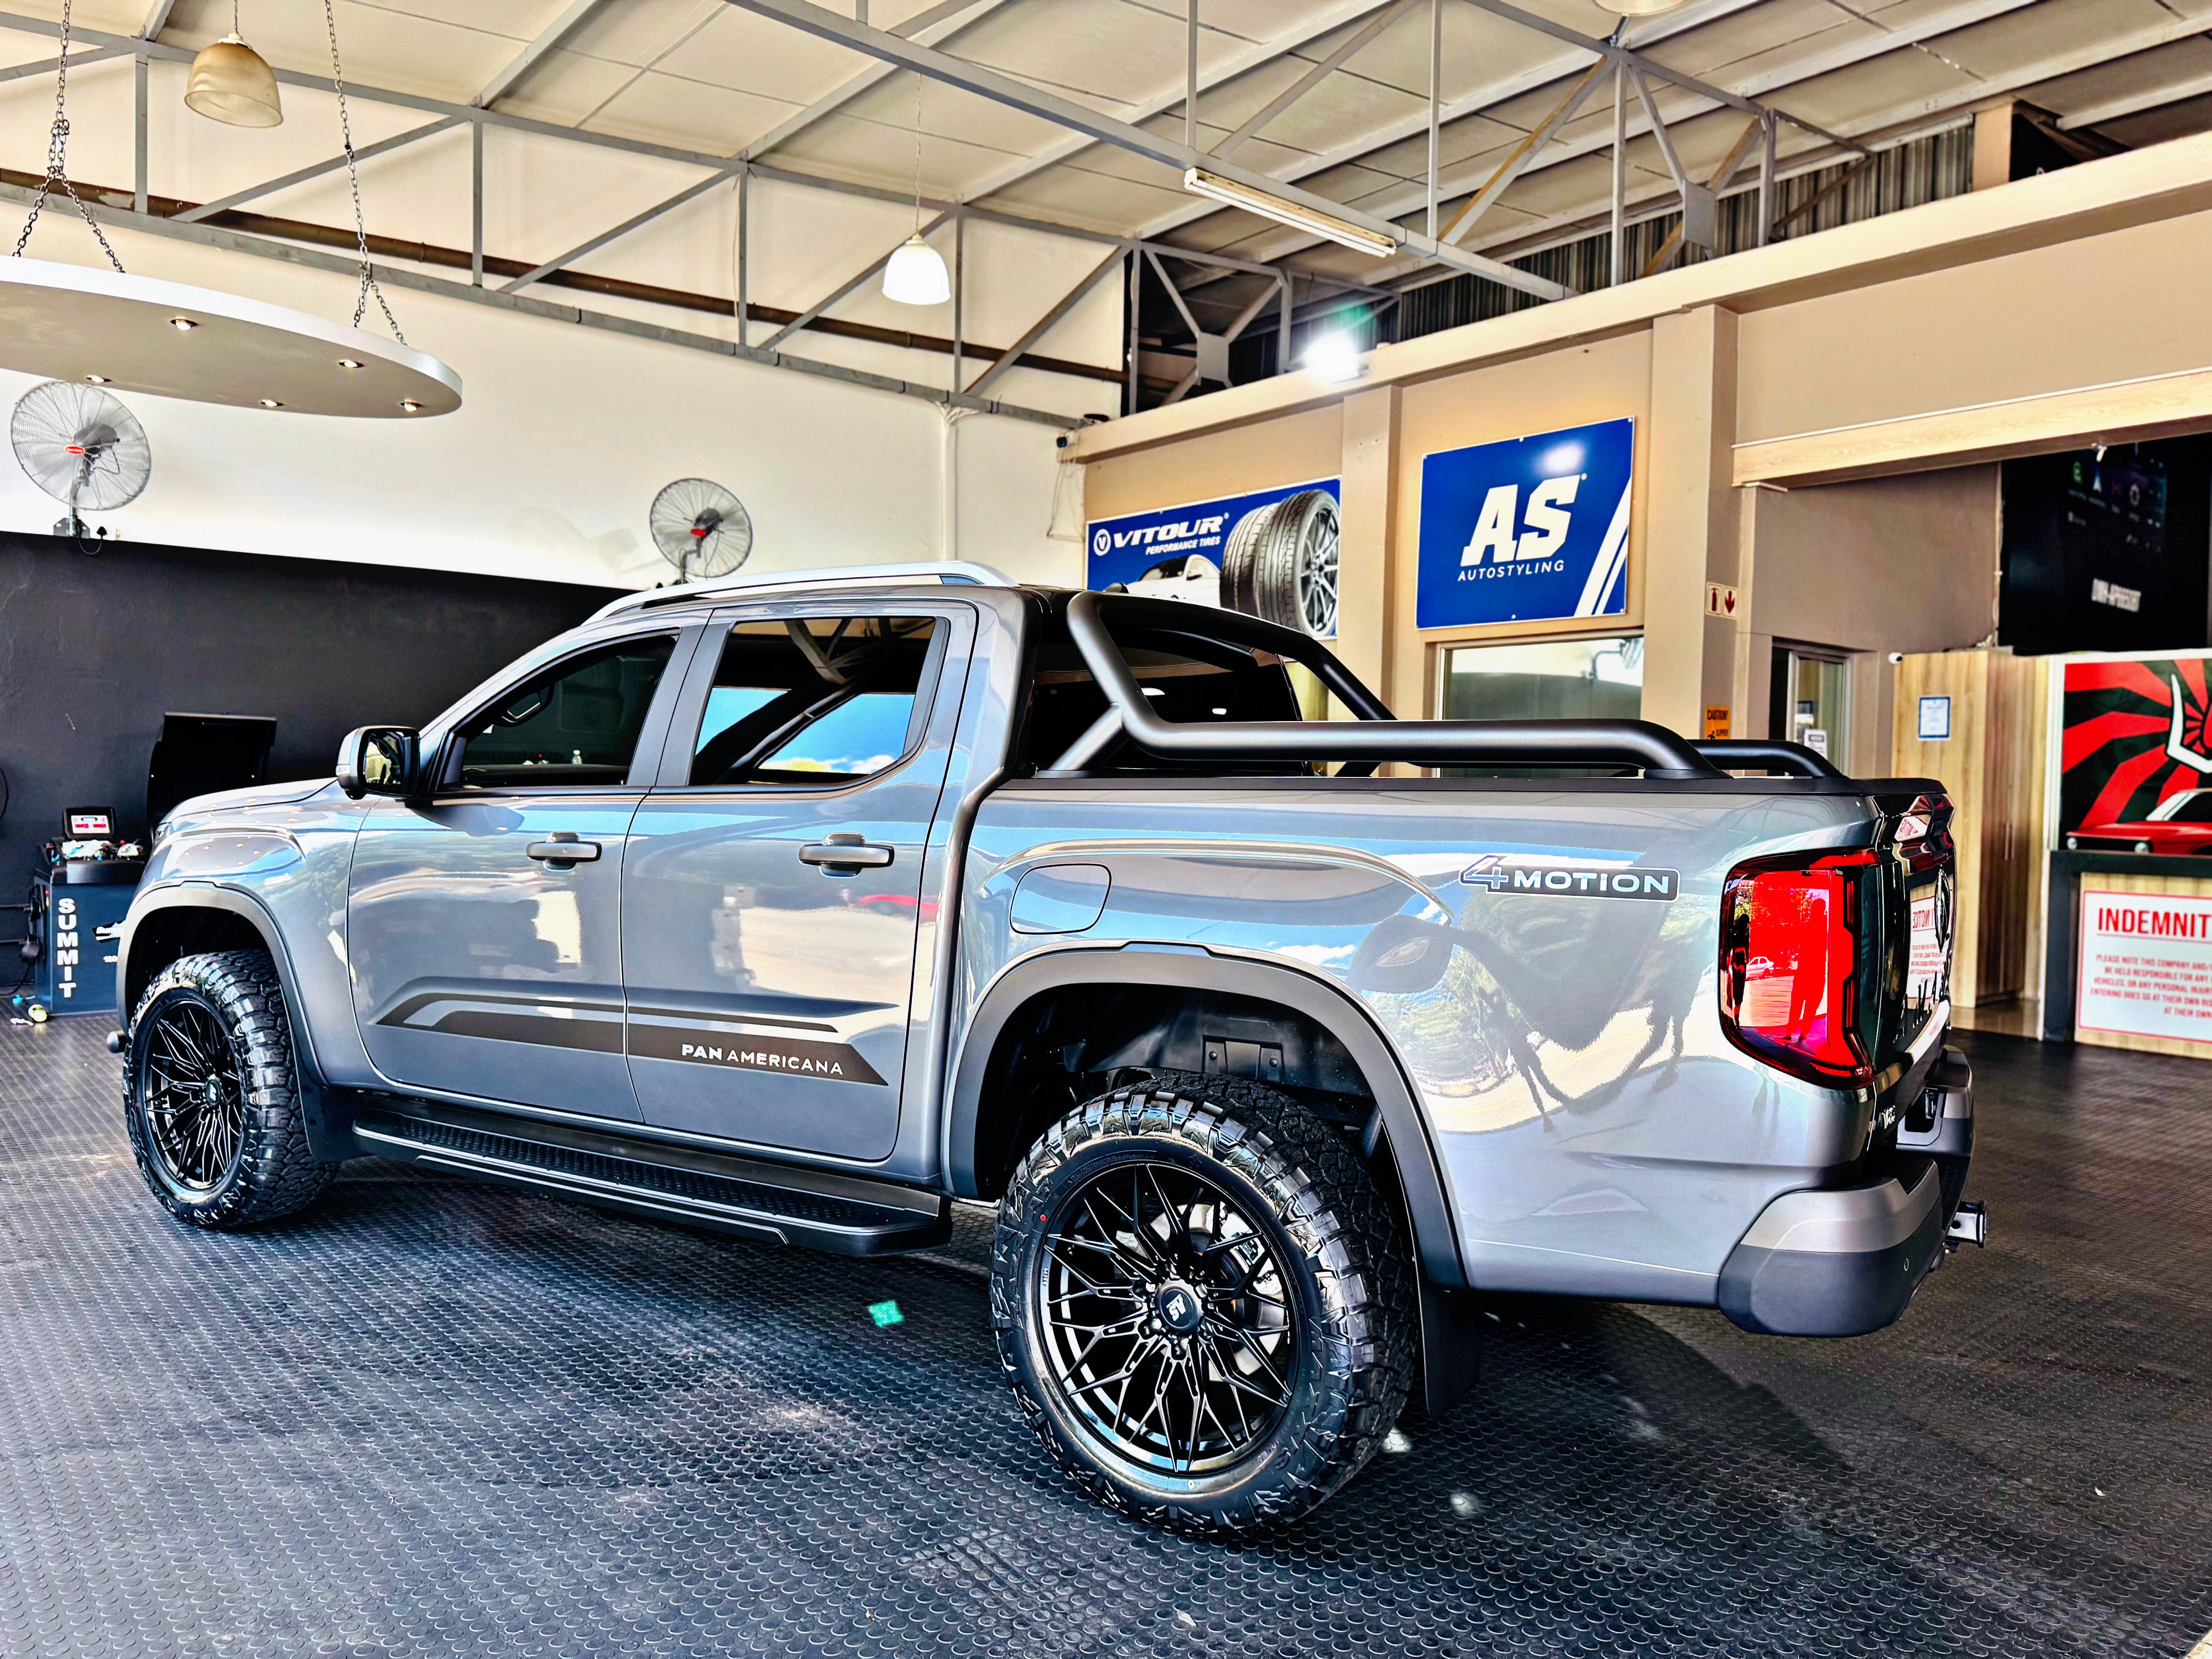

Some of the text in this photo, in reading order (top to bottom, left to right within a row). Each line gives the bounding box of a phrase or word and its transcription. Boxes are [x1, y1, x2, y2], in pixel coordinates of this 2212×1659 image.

[1113, 516, 1223, 548] VITOUR
[1460, 474, 1580, 567] AS
[1145, 536, 1221, 555] PERFORMANCE TIRES
[1458, 560, 1564, 581] AUTOSTYLING
[2098, 907, 2212, 938] INDEMNIT
[58, 898, 78, 998] SUMMIT
[2122, 956, 2138, 964] NOTE
[2157, 959, 2189, 969] COMPANY
[2133, 969, 2177, 980] RESPONSIBLE
[682, 1044, 843, 1075] PAN AMERICANA
